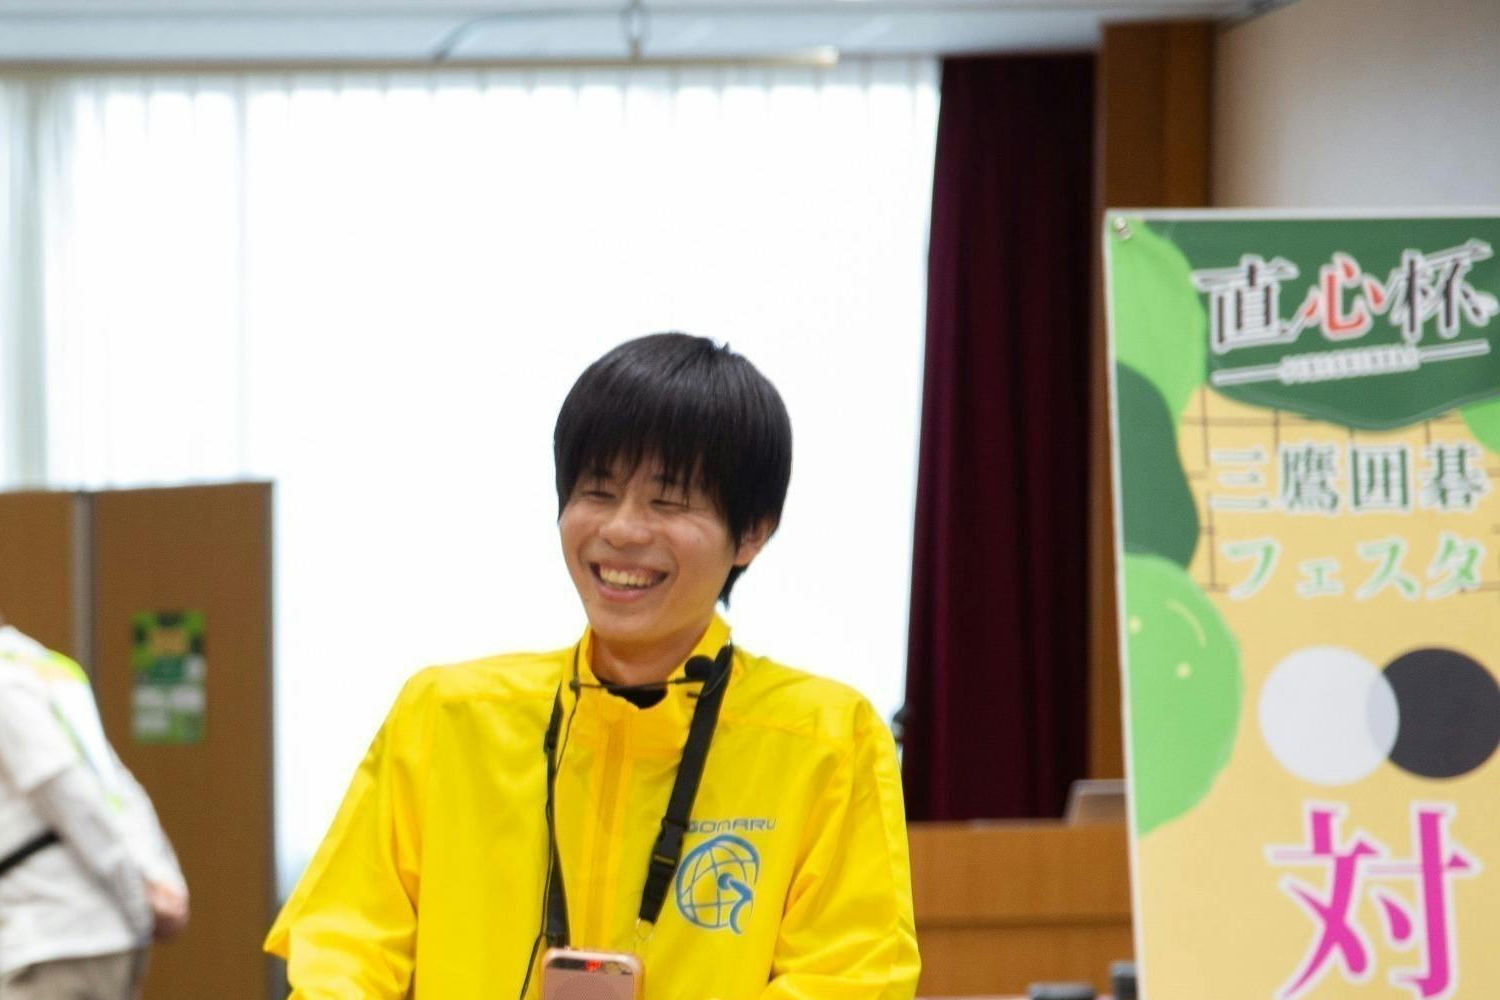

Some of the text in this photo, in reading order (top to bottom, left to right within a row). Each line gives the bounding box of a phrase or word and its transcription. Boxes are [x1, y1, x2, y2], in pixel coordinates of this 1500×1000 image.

[1190, 238, 1500, 352] 直心杯
[1208, 444, 1488, 513] 三鷹囲碁
[1221, 535, 1485, 599] フェスタ
